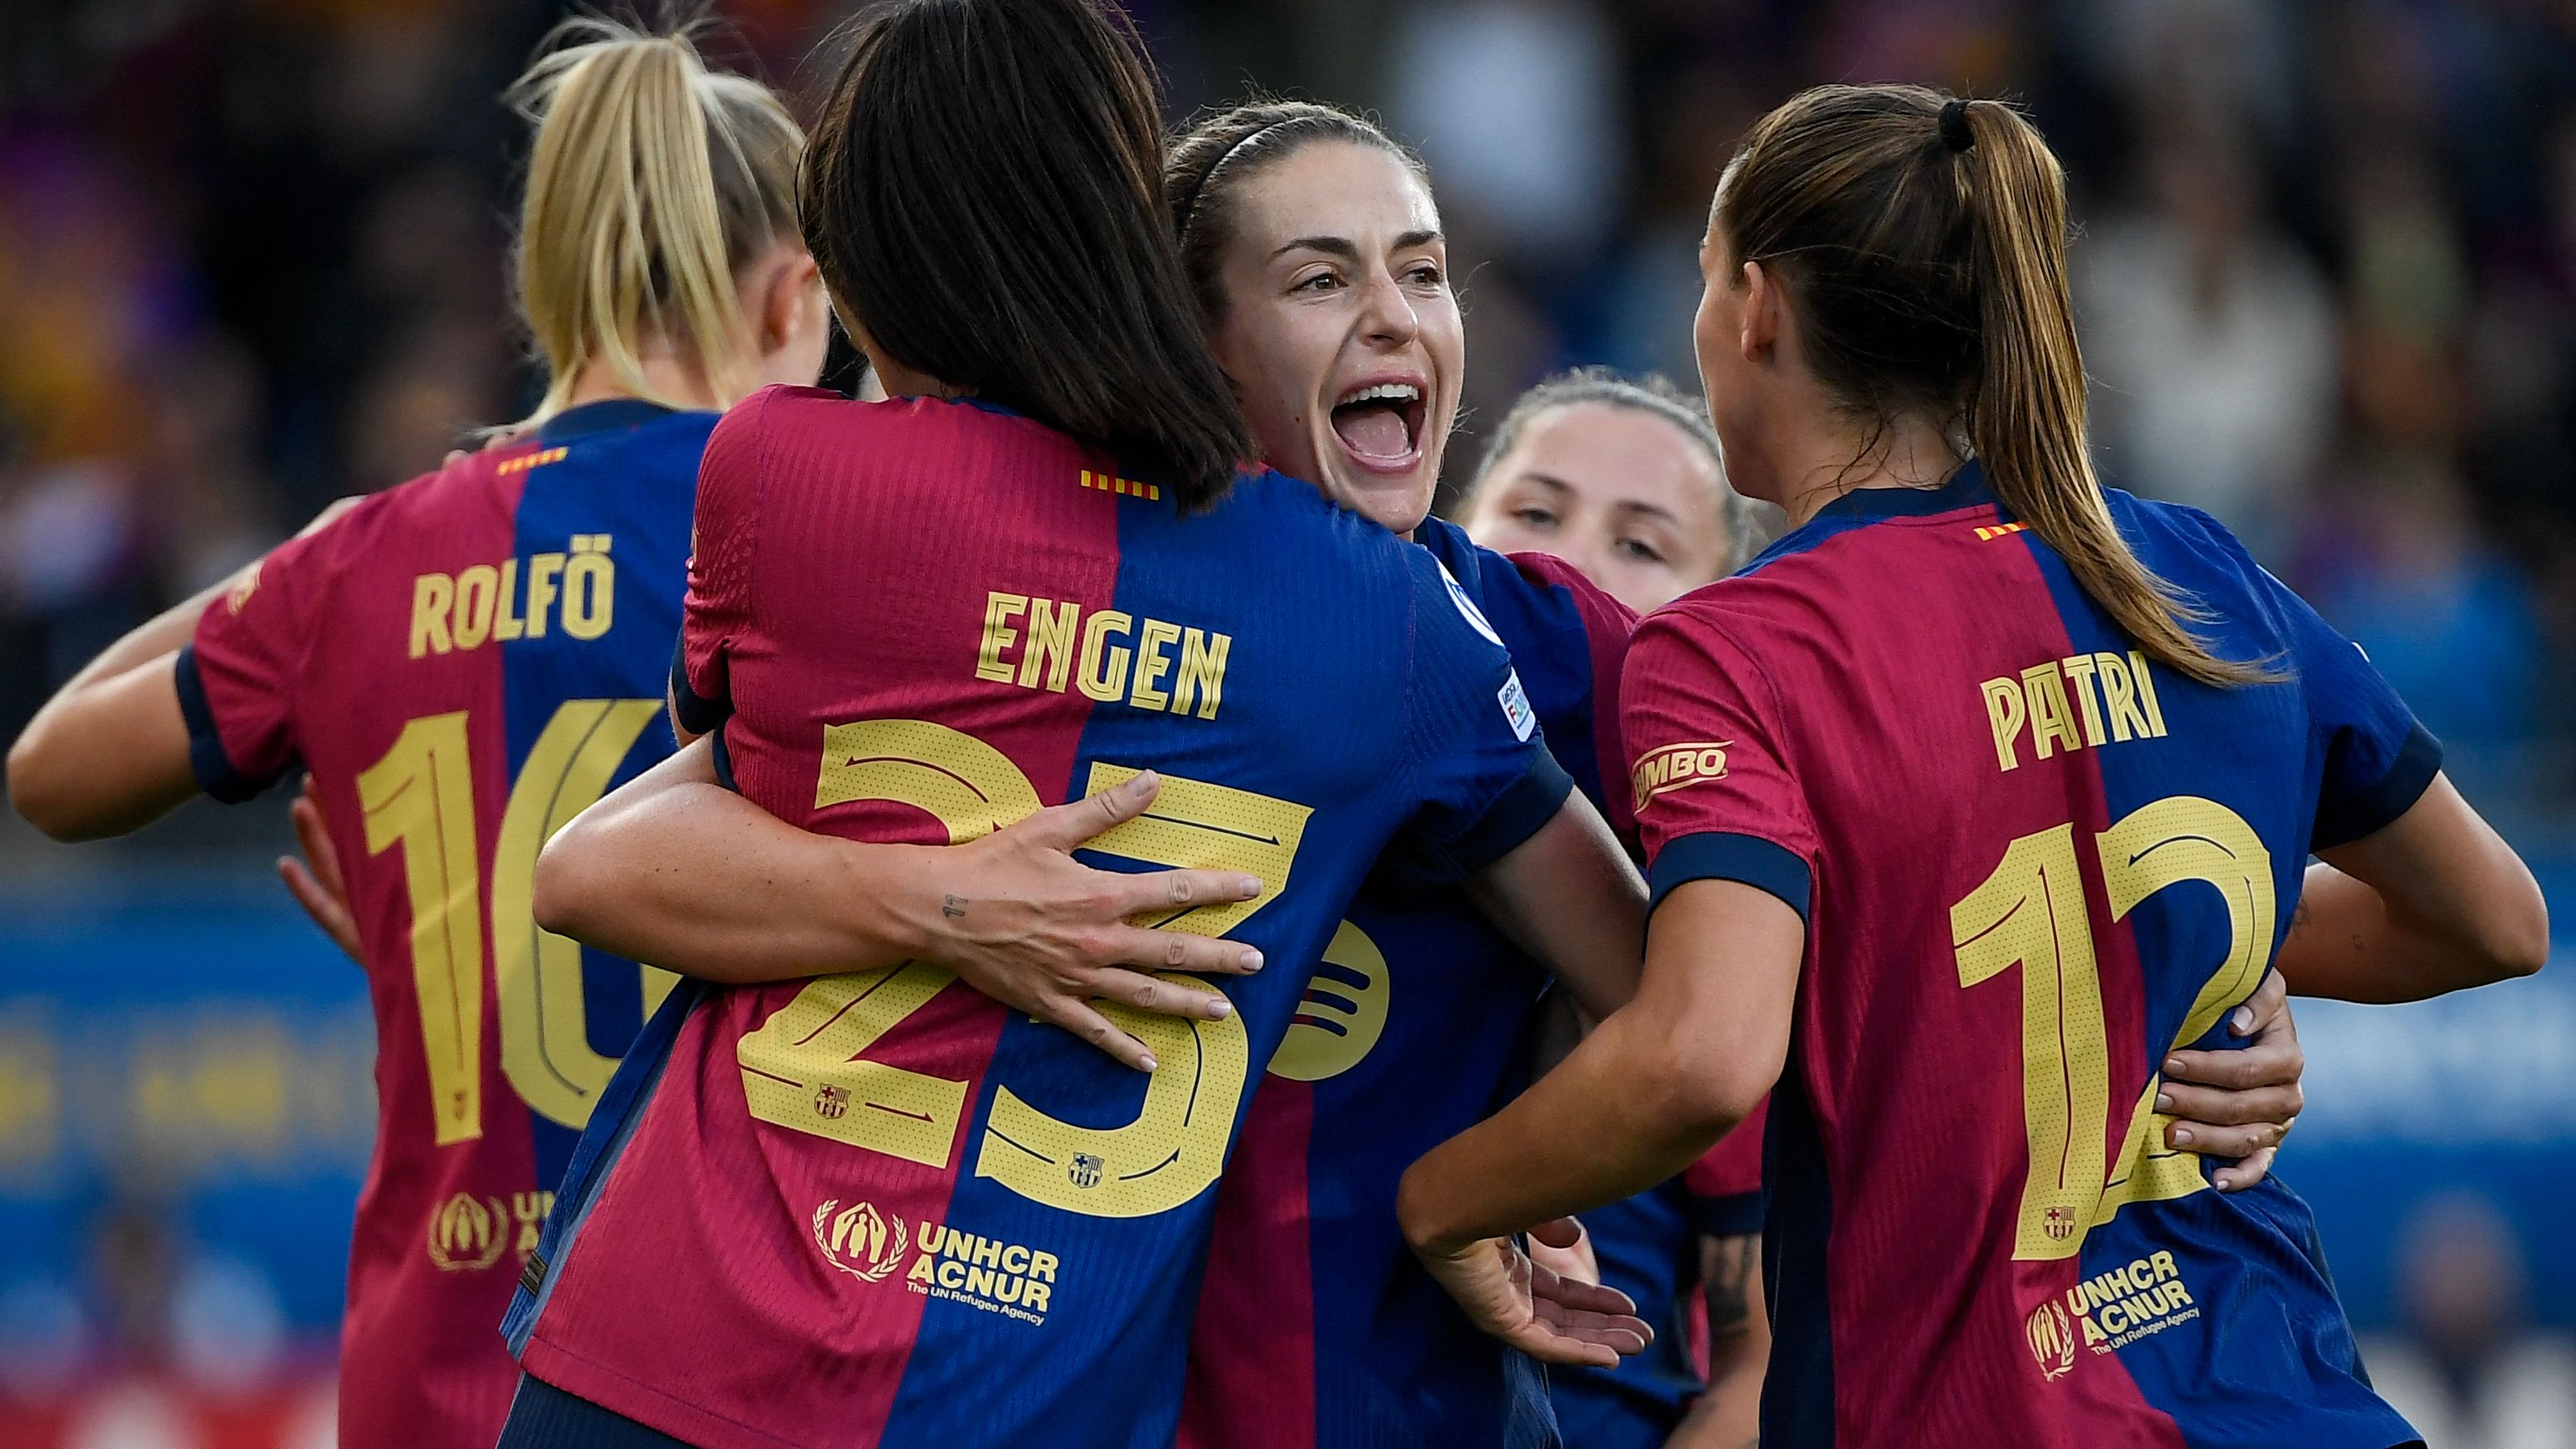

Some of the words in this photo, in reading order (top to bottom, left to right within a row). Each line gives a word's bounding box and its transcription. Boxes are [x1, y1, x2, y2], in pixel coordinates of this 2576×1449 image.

[409, 533, 615, 658] ROLFÖ
[975, 590, 1233, 721] ENGEN
[1980, 650, 2168, 772] PATRI
[357, 698, 682, 1146] 16
[737, 718, 1315, 1219] 23
[1949, 795, 2276, 1261] 12
[907, 1253, 1052, 1313] ACNUR
[917, 1221, 1059, 1284] UNHCR
[2066, 1250, 2179, 1316] UNHCR
[907, 1280, 929, 1295] The
[930, 1286, 950, 1300] UN
[951, 1290, 1000, 1313] Refugee
[1000, 1304, 1045, 1326] Agency
[2080, 1280, 2194, 1347] ACNUR
[2090, 1344, 2113, 1356] The
[2109, 1334, 2129, 1349] UN
[2126, 1319, 2168, 1343] Refugee
[2165, 1306, 2201, 1326] Agency
